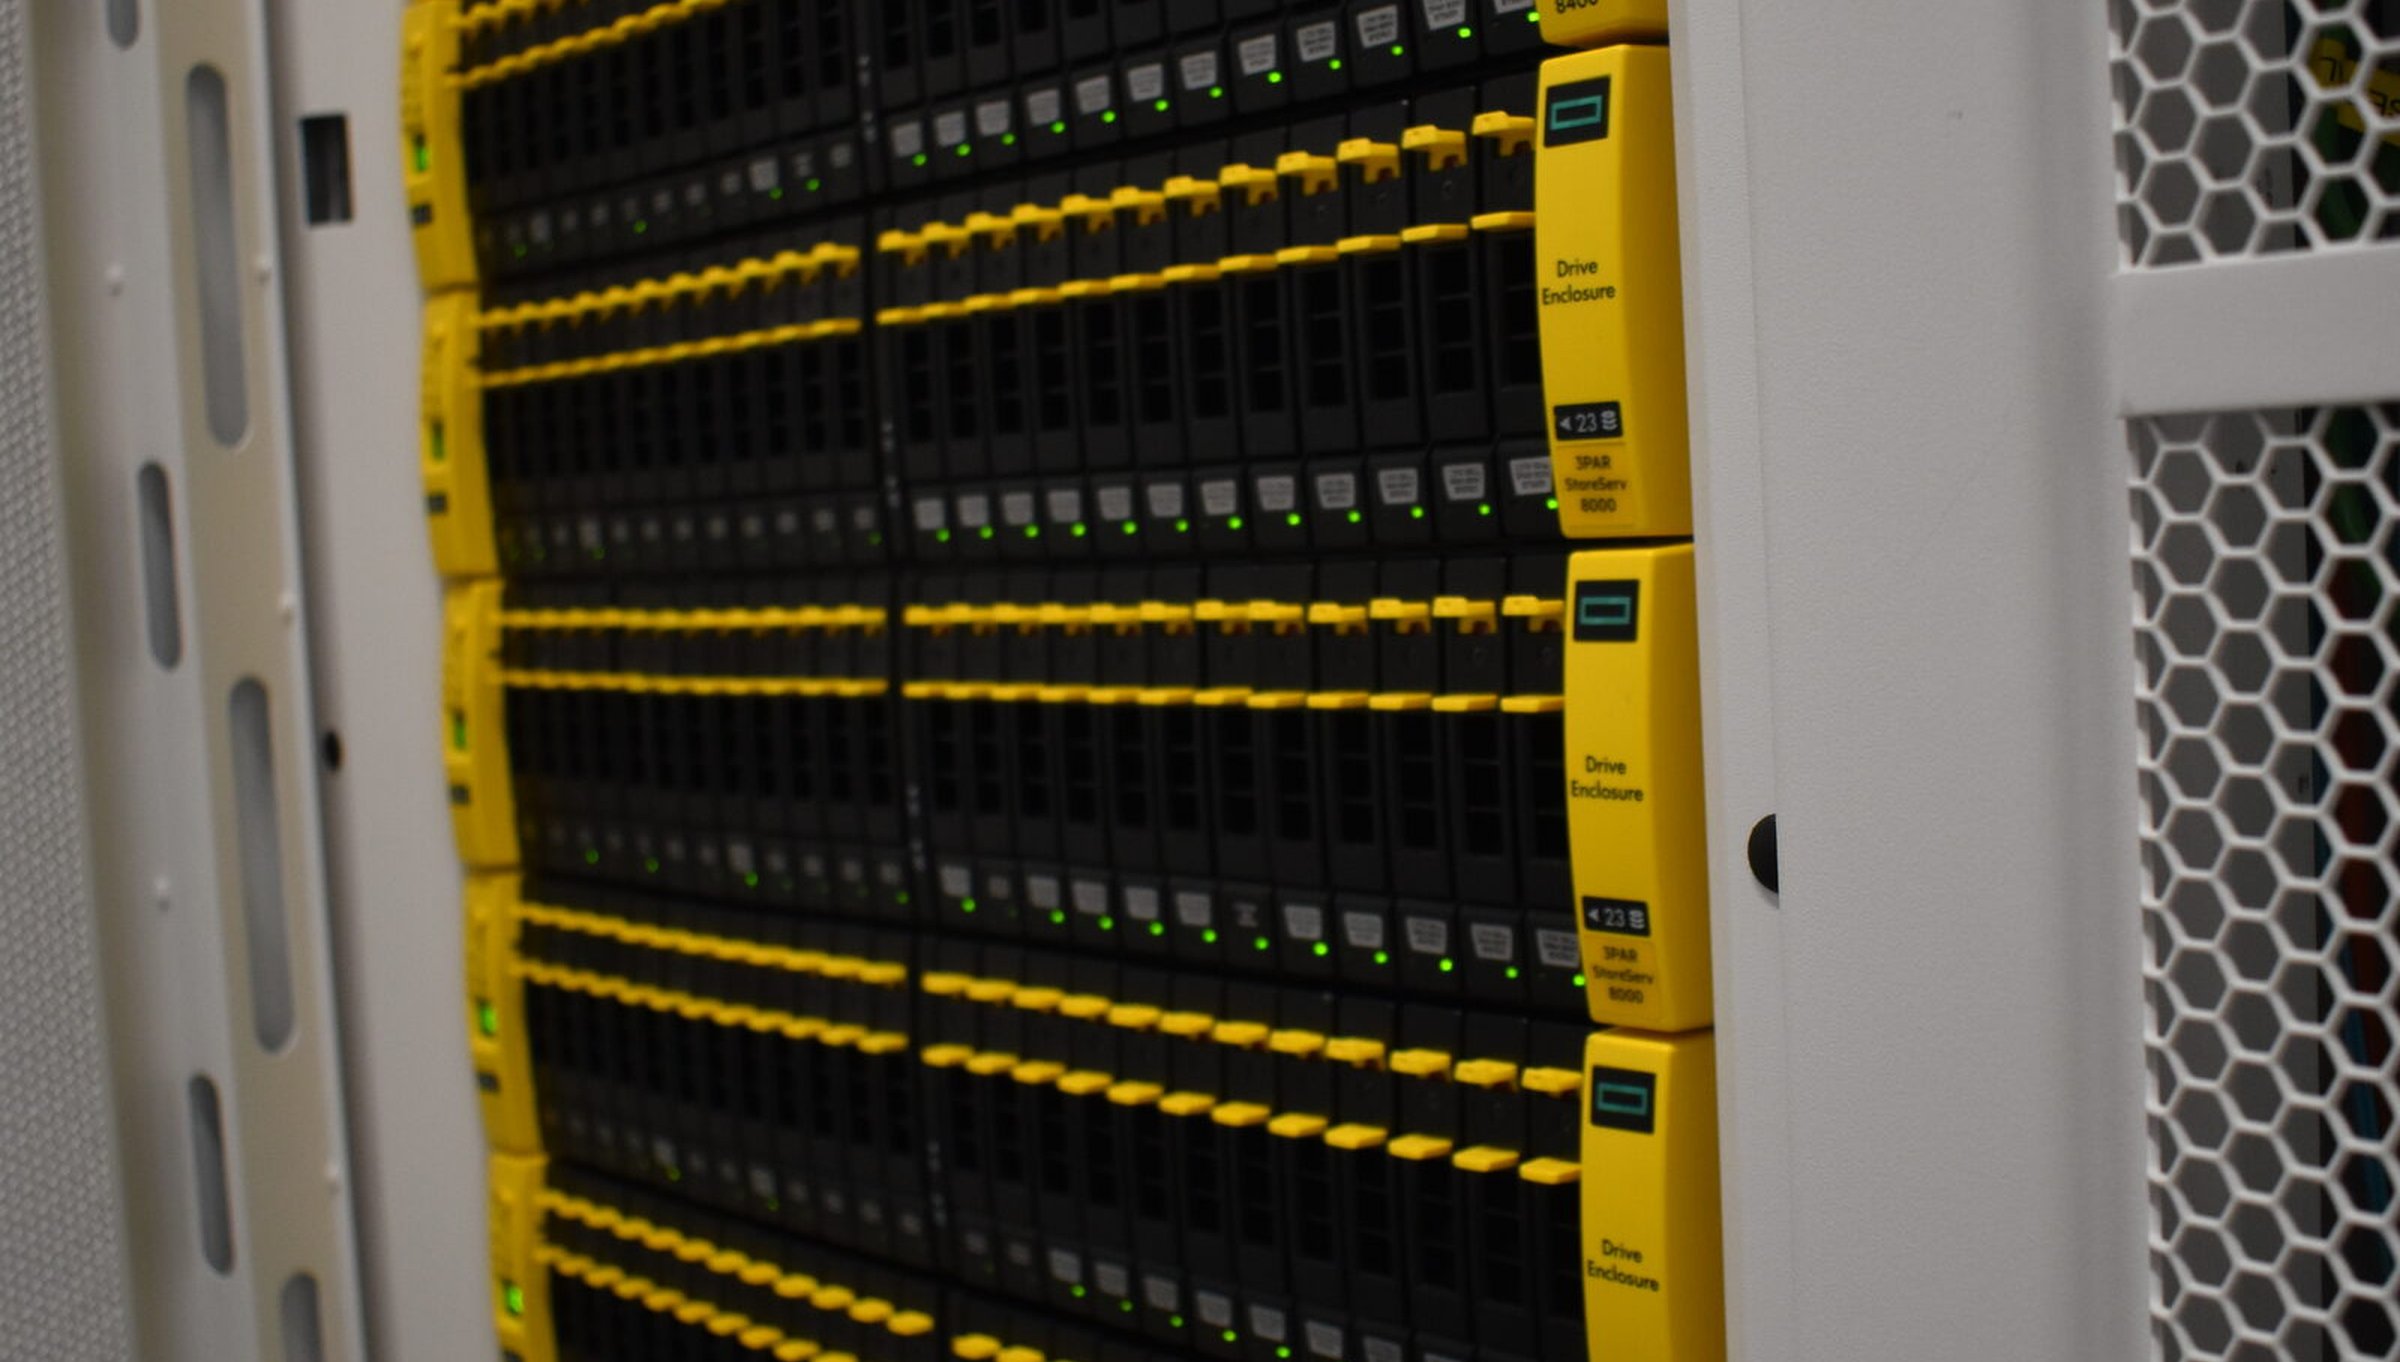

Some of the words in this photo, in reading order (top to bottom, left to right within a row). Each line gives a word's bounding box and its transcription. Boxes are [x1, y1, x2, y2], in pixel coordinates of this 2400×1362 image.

[1557, 258, 1598, 278] Drive
[1542, 284, 1616, 305] Enclosure
[1575, 413, 1597, 433] 23
[1575, 455, 1612, 470] 3PAR
[1564, 476, 1627, 492] StoreServ
[1581, 497, 1616, 513] 8000
[1586, 755, 1627, 775] Drive
[1571, 780, 1644, 802] Enclosure
[1604, 908, 1626, 928] 23
[1602, 945, 1638, 963] 3PAR
[1592, 965, 1654, 985] StoreServ
[1602, 1238, 1643, 1264] Drive
[1587, 1259, 1660, 1292] Enclosure
